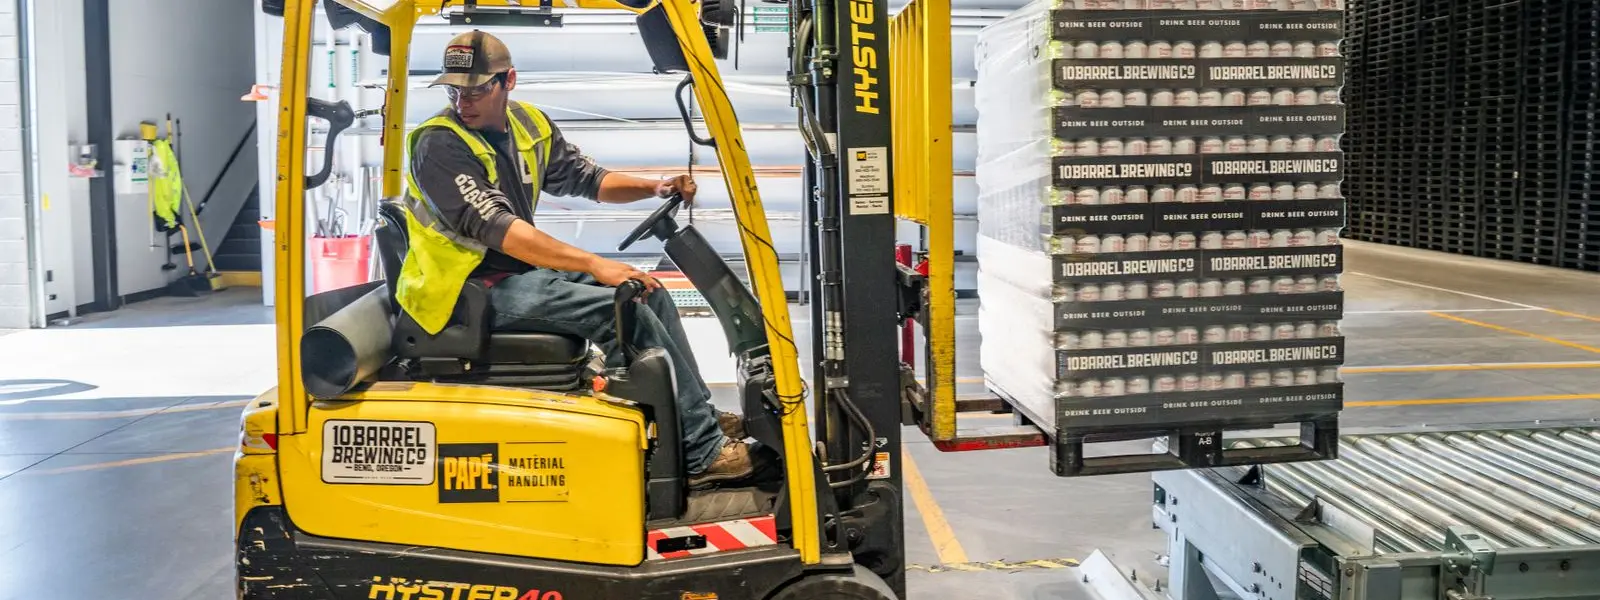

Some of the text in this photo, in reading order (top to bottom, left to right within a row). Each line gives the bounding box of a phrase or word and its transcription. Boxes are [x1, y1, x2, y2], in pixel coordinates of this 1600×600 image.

[850, 0, 879, 114] HYSTE
[1123, 65, 1178, 79] BREWING
[1267, 65, 1320, 79] BREWING
[1120, 163, 1175, 178] BREWING
[1270, 159, 1322, 174] BREWING
[1123, 259, 1177, 274] BREWING
[1268, 254, 1320, 269] BREWING
[1127, 352, 1181, 368] BREWING
[1269, 346, 1321, 362] BREWING
[1198, 437, 1212, 445] A-B
[332, 446, 404, 464] BREWING
[508, 474, 565, 487] HANDLING
